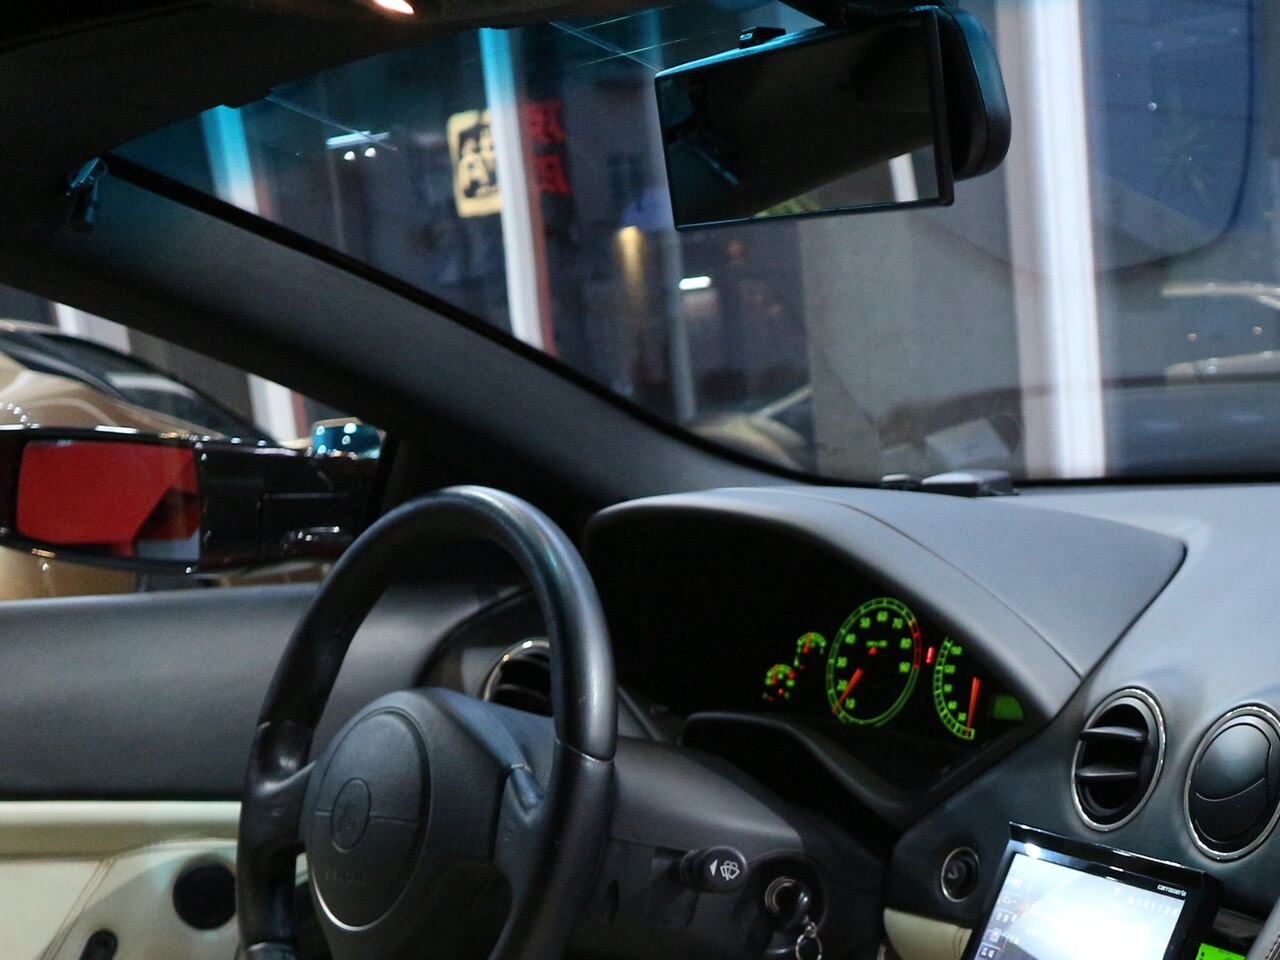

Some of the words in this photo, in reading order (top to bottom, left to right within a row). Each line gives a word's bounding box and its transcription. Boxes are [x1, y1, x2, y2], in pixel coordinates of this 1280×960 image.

[876, 610, 888, 622] 60
[860, 617, 871, 629] 50
[892, 618, 903, 629] 70
[836, 656, 848, 668] 30
[845, 698, 856, 710] 10
